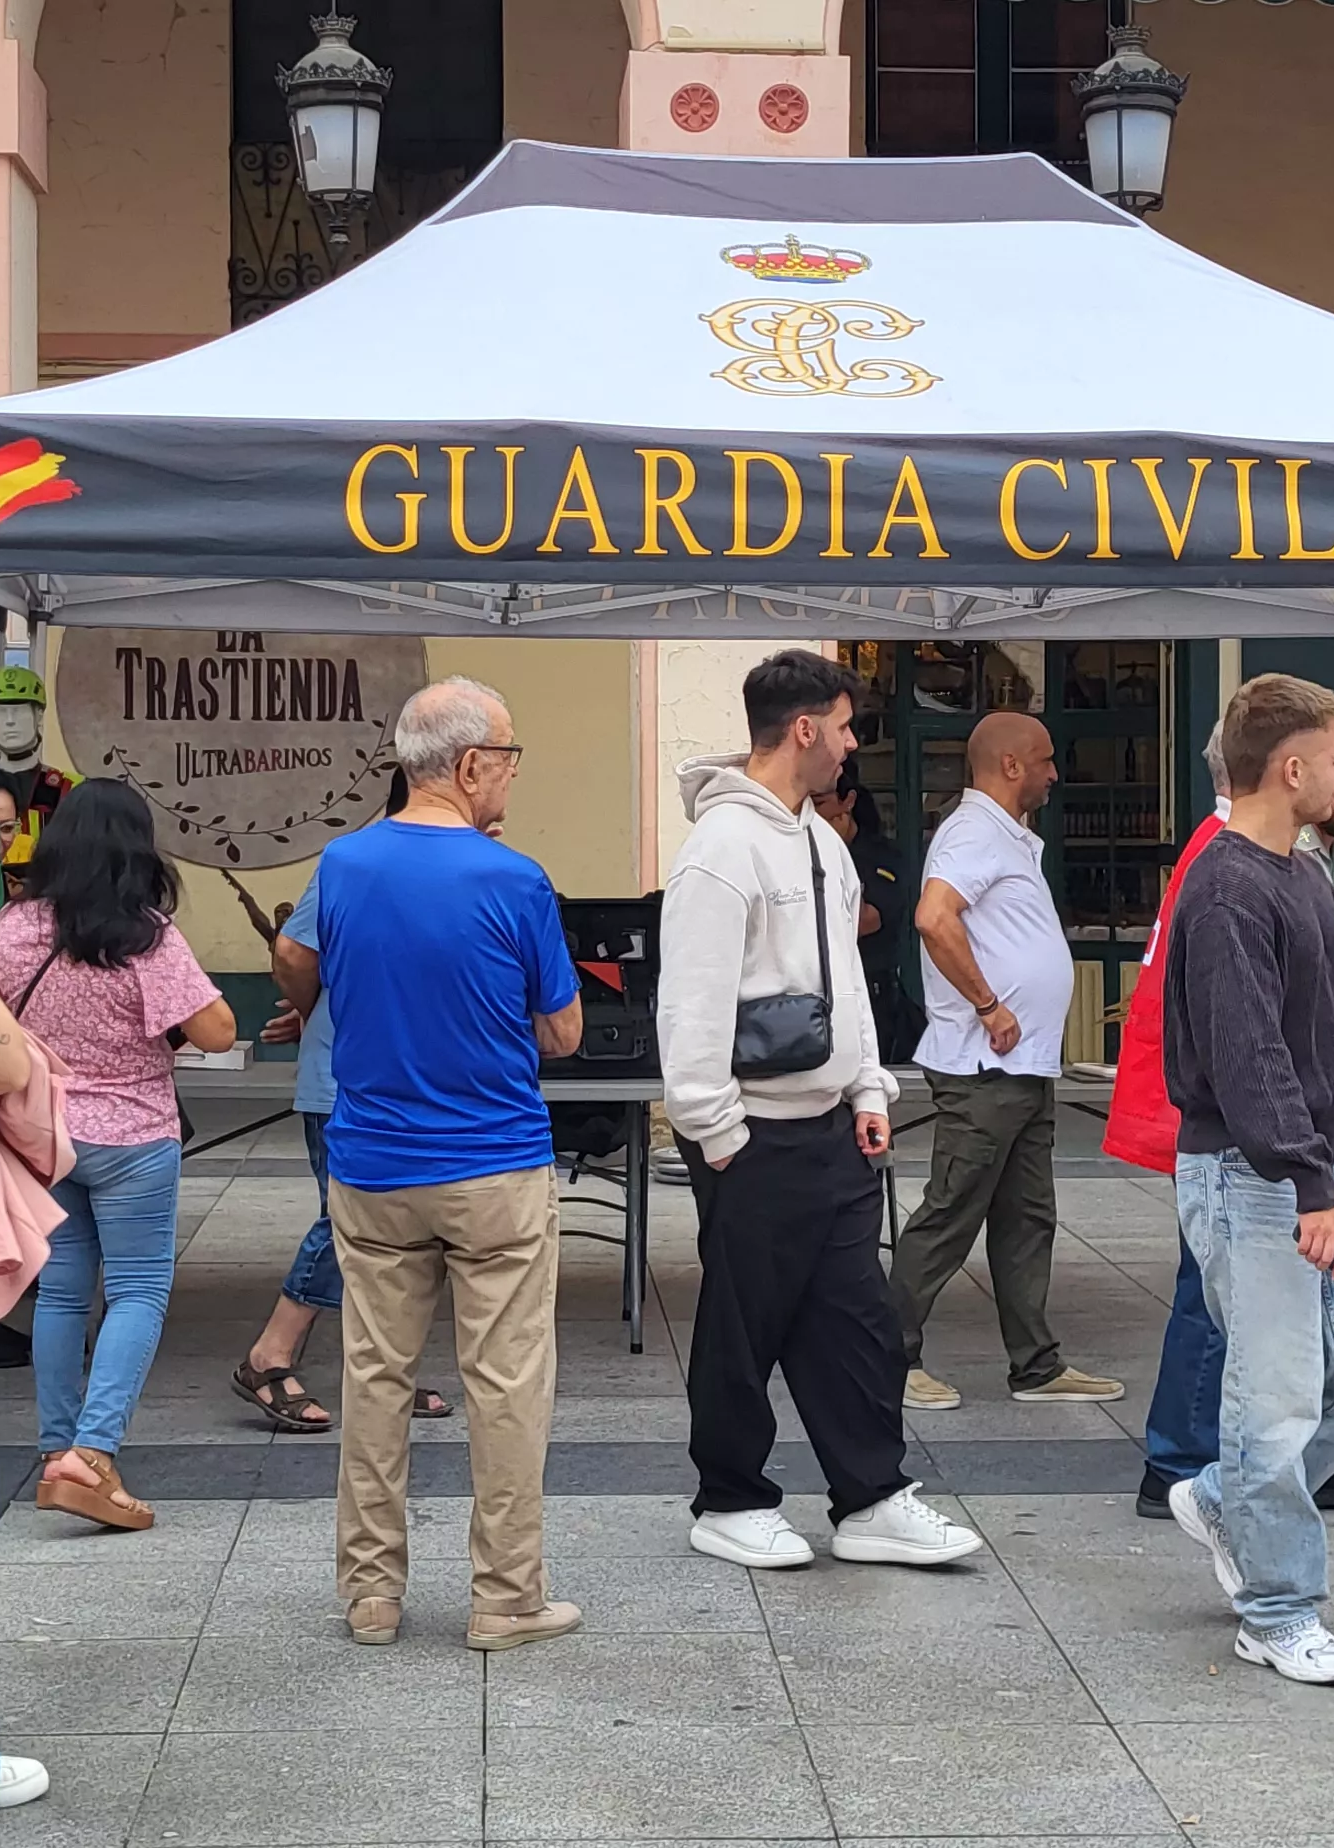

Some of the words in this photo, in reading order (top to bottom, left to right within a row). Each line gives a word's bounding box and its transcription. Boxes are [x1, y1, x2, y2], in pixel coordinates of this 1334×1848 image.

[345, 443, 951, 559] GUARDIA
[115, 648, 365, 722] TRASTIENDA
[175, 742, 332, 787] ULTRABARINOS
